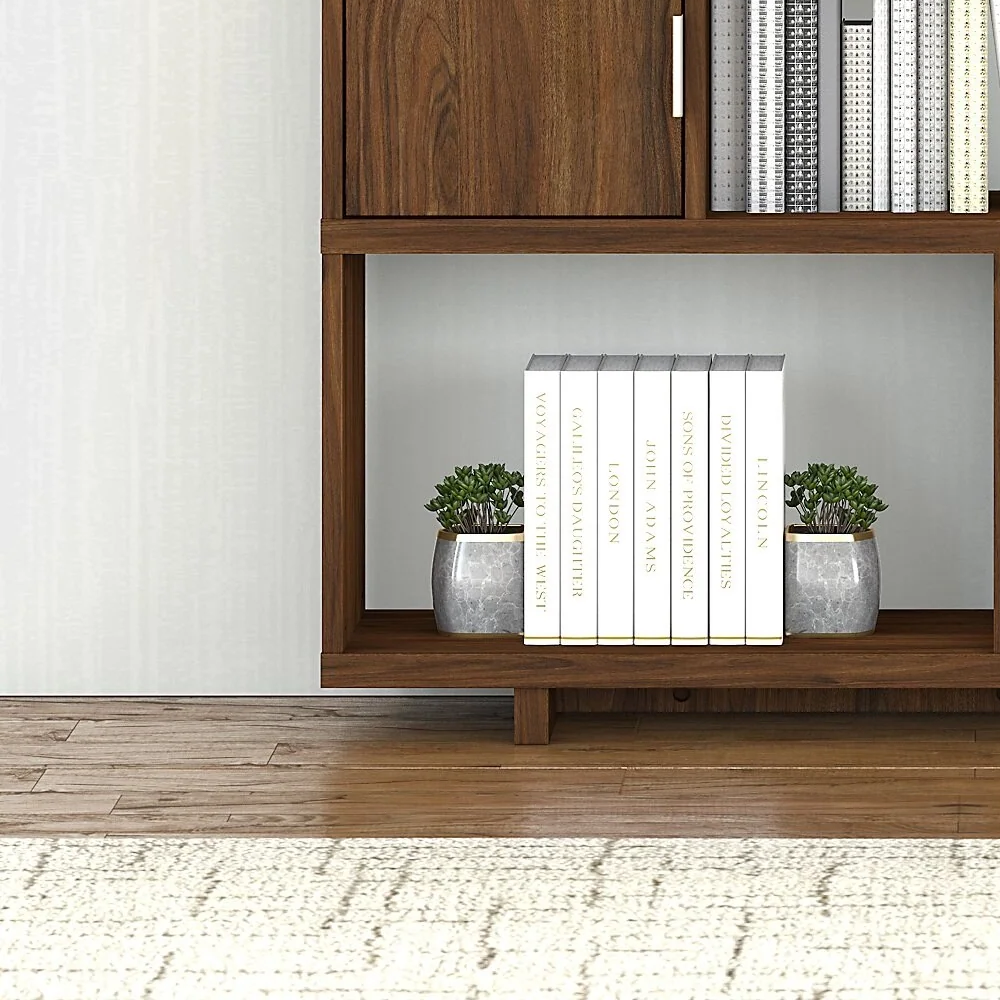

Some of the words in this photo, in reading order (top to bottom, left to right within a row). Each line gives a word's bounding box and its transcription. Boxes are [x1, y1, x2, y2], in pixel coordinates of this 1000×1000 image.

[536, 392, 547, 487] VOYAGERS
[645, 439, 657, 490] JOHN
[682, 411, 694, 456] SONS
[720, 415, 732, 487] DIVIDED
[536, 492, 547, 517] TO
[608, 463, 620, 544] LONDON
[682, 460, 694, 484] OF
[757, 457, 768, 549] LINCOLN
[571, 501, 583, 597] DAUGHTER
[645, 501, 657, 573] ADAMS
[682, 490, 694, 600] PROVIDENCE
[720, 492, 732, 590] LOYALTIES
[536, 564, 547, 612] WEST
